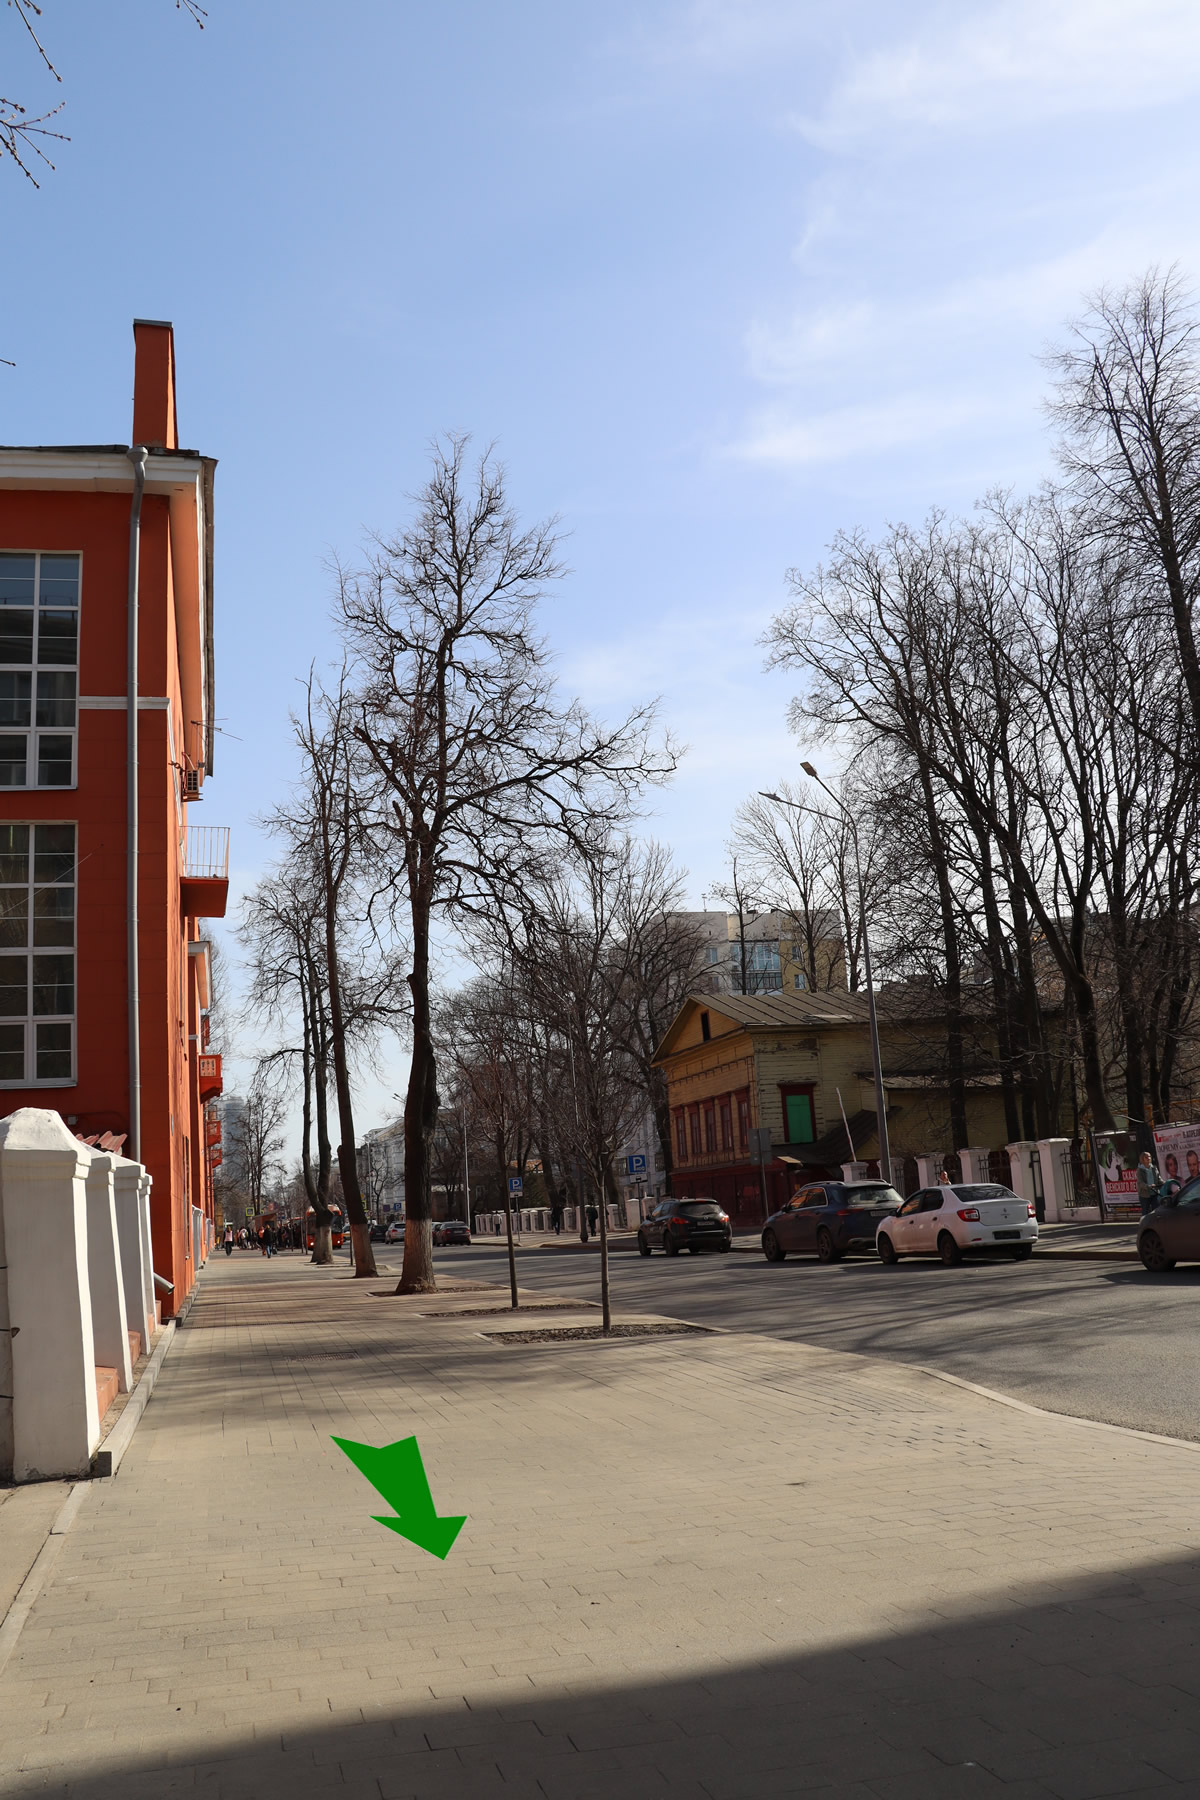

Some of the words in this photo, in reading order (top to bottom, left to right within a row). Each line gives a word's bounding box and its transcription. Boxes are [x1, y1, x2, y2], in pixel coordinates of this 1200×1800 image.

[633, 1157, 642, 1171] P
[512, 1179, 520, 1189] P
[1106, 1182, 1129, 1192] ВЕНСКОГО
